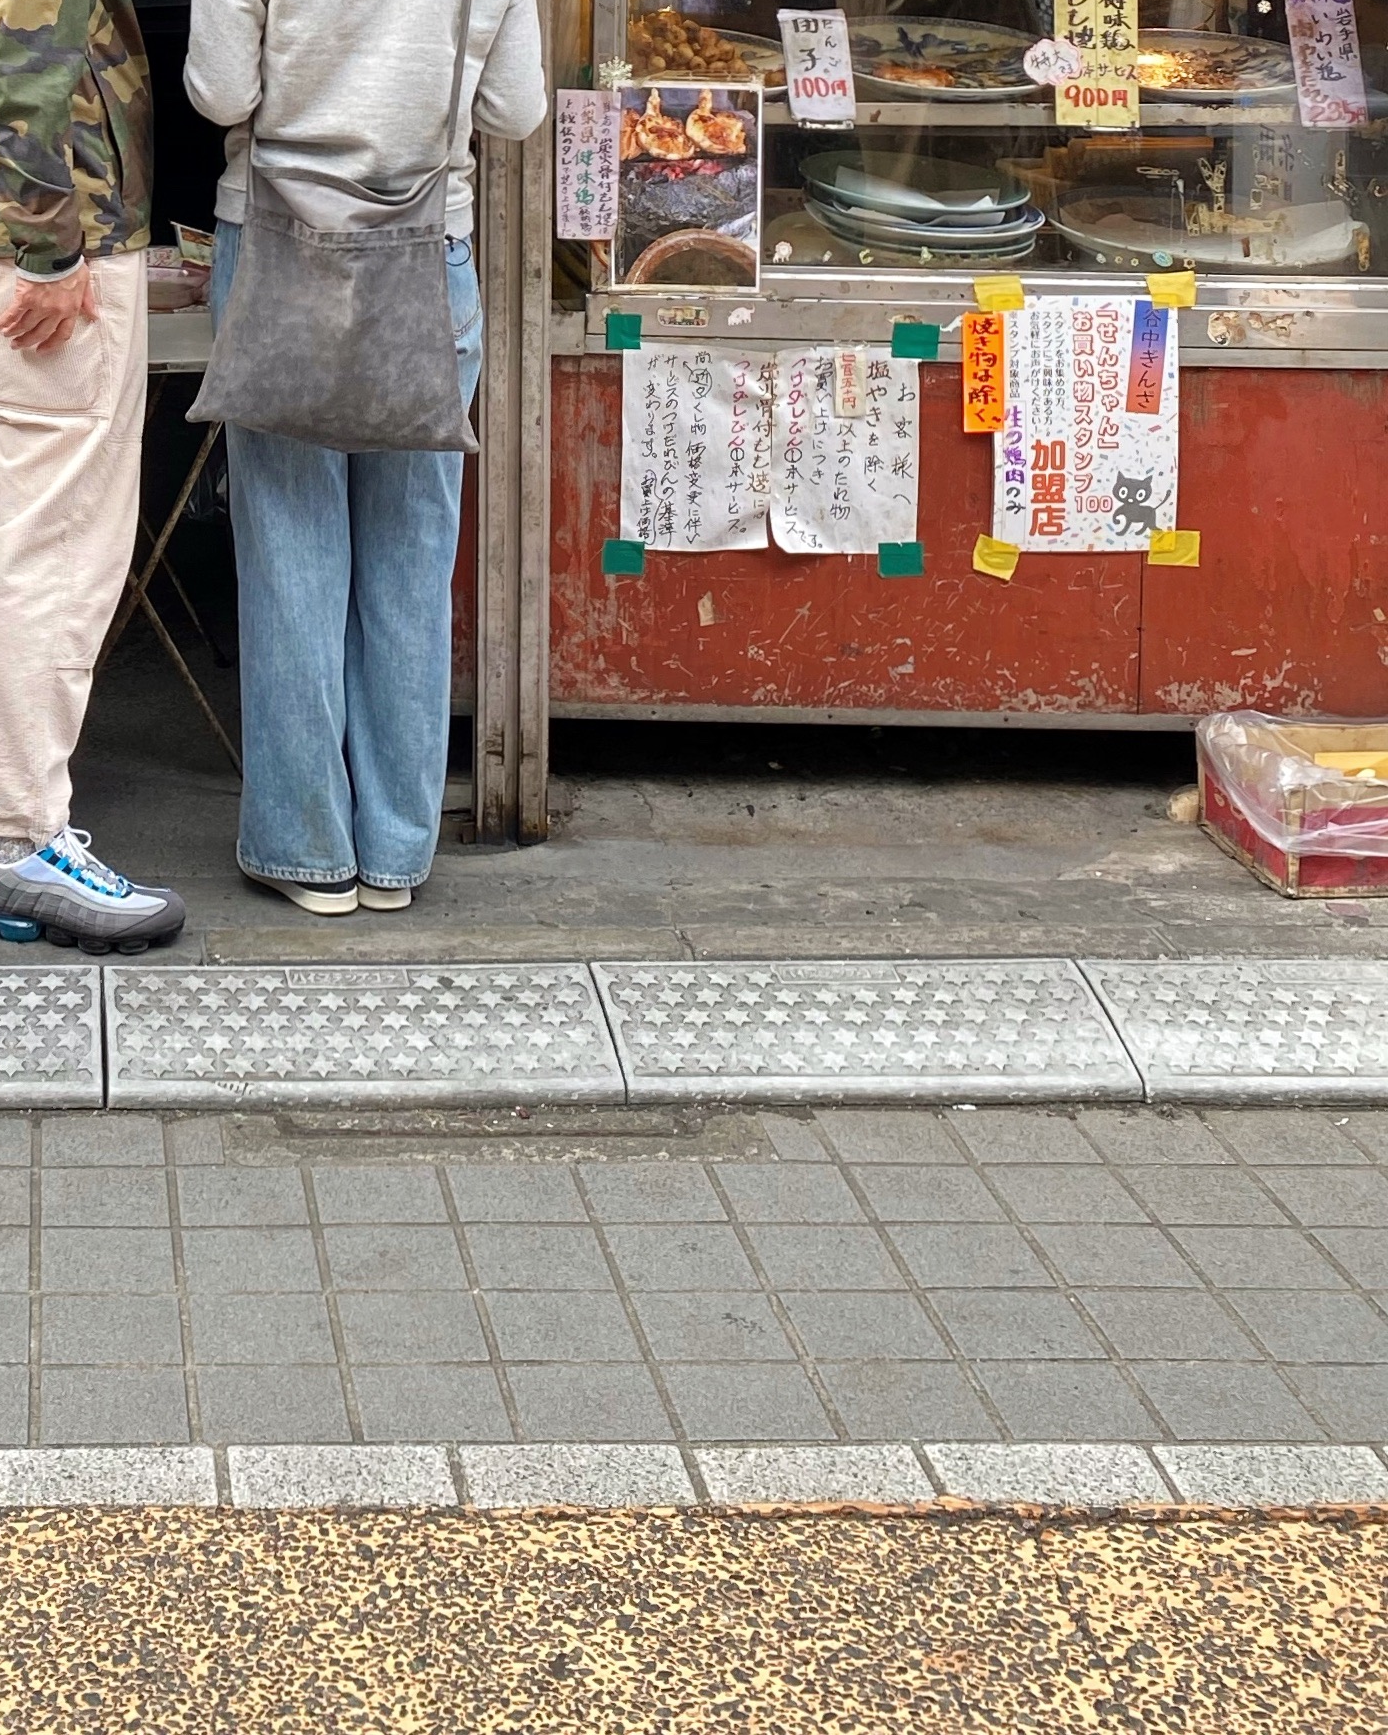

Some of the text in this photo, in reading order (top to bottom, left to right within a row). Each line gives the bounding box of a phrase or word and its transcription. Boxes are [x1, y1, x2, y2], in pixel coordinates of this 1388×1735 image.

[791, 18, 821, 72] 団子
[1310, 12, 1347, 82] いわい鶏
[1335, 7, 1358, 62] 岩手県
[793, 76, 847, 98] 100円
[1063, 84, 1129, 108] 900円
[1095, 308, 1120, 450] 「せんちゃん」
[1136, 306, 1163, 410] 谷中ぎんざ
[863, 360, 892, 493] 塩やきを除く
[891, 382, 916, 506] お客様へ
[1002, 405, 1027, 515] 生の鶏肉のみ
[1072, 310, 1113, 513] お買い物スタンプ 100
[829, 422, 857, 522] 以上のたれ物
[1029, 439, 1067, 537] 加盟店
